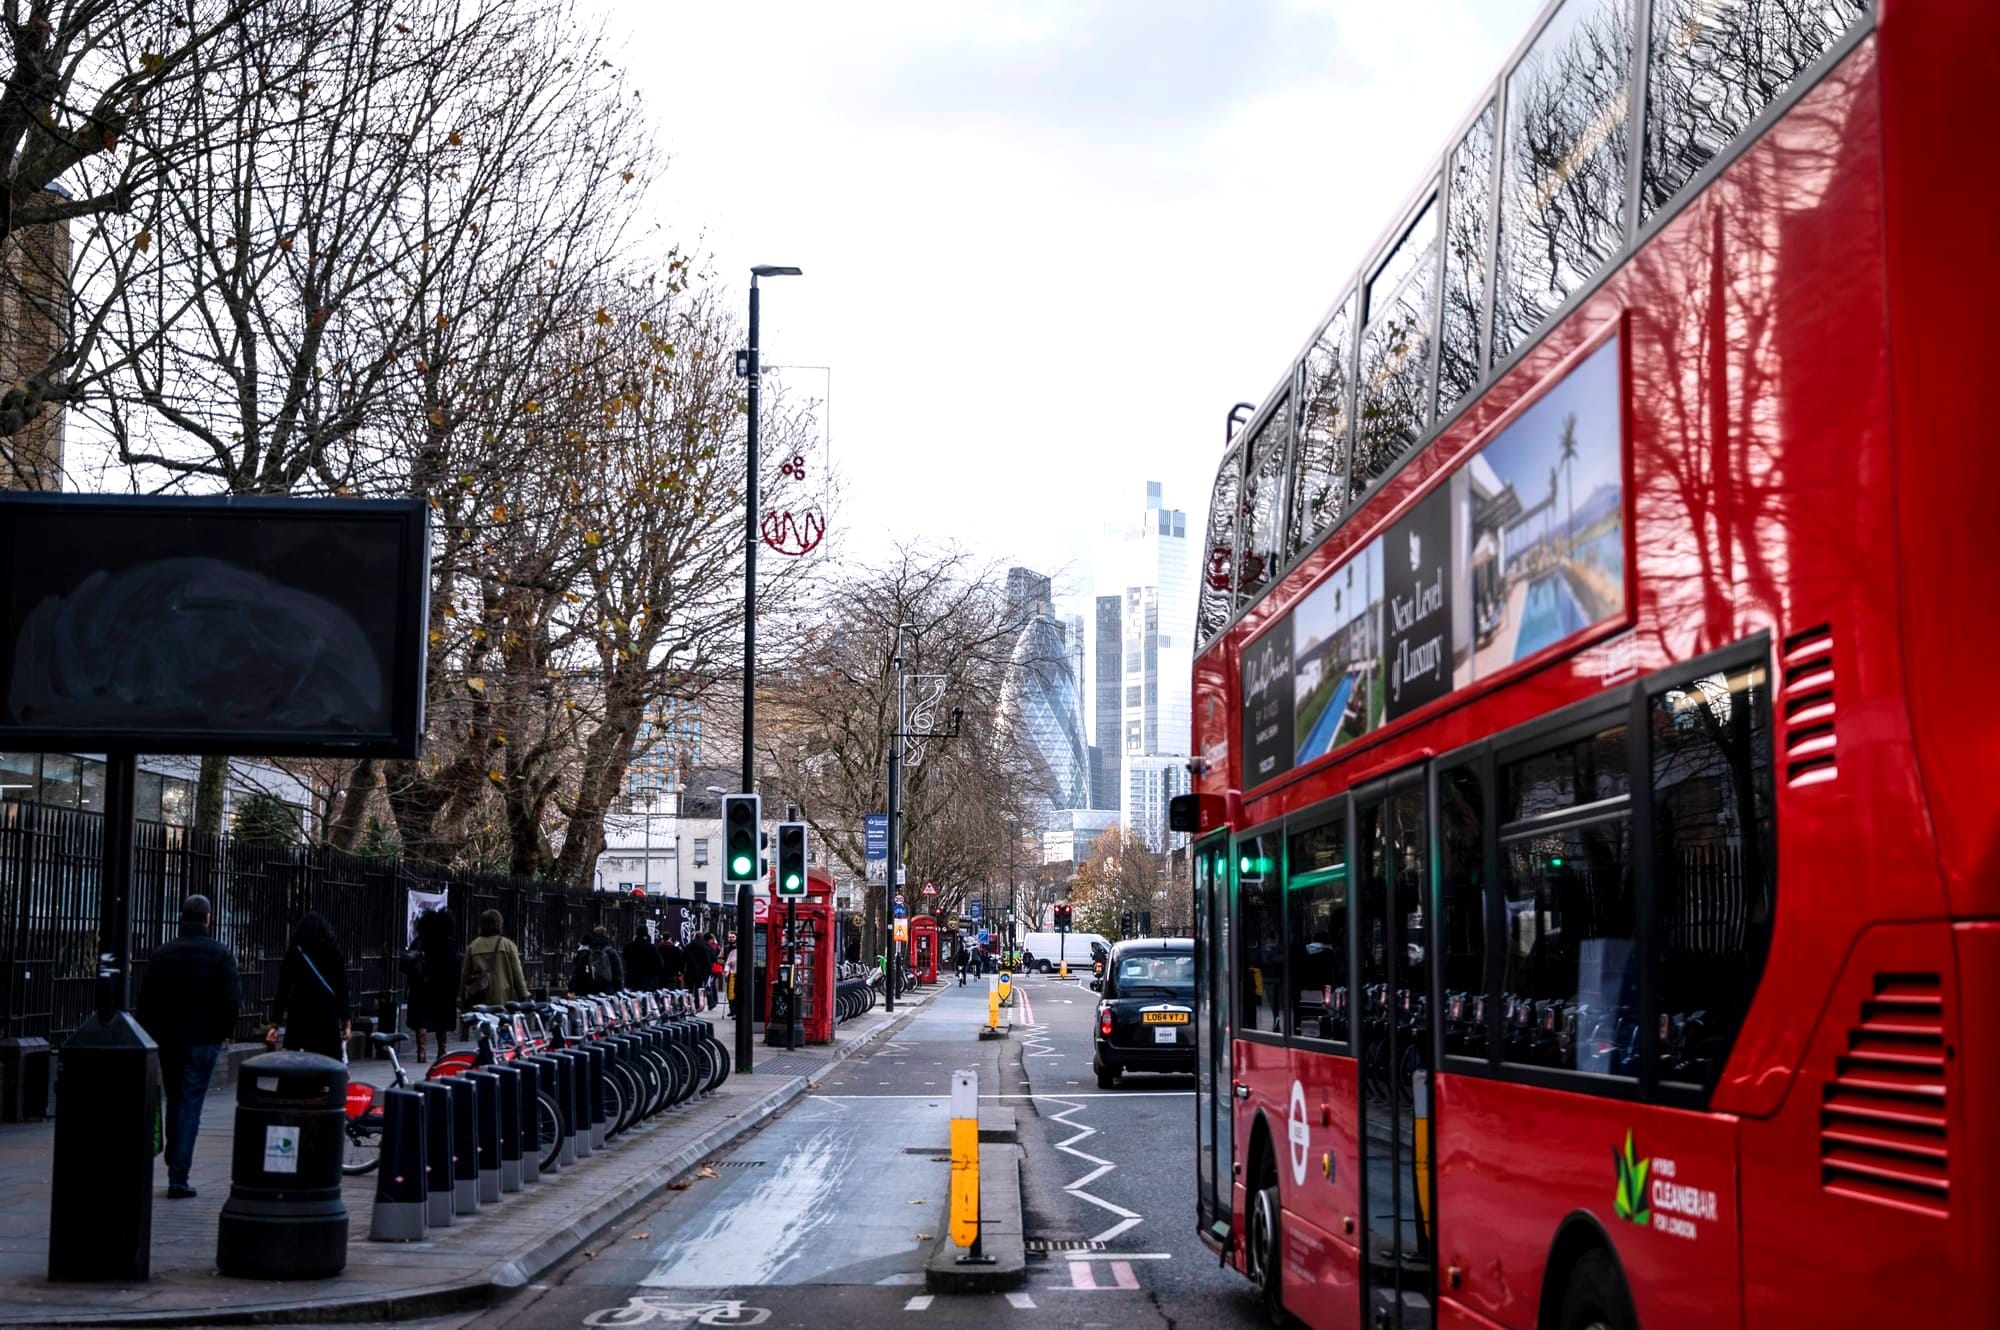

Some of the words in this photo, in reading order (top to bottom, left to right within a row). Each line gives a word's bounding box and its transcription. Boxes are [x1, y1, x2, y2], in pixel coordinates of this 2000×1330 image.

[1391, 595, 1414, 637] Next
[1415, 566, 1442, 622] Level
[1391, 639, 1408, 702] of
[1402, 634, 1443, 682] Luxury
[1146, 1013, 1167, 1021] LO64
[1169, 1013, 1185, 1021] VTJ
